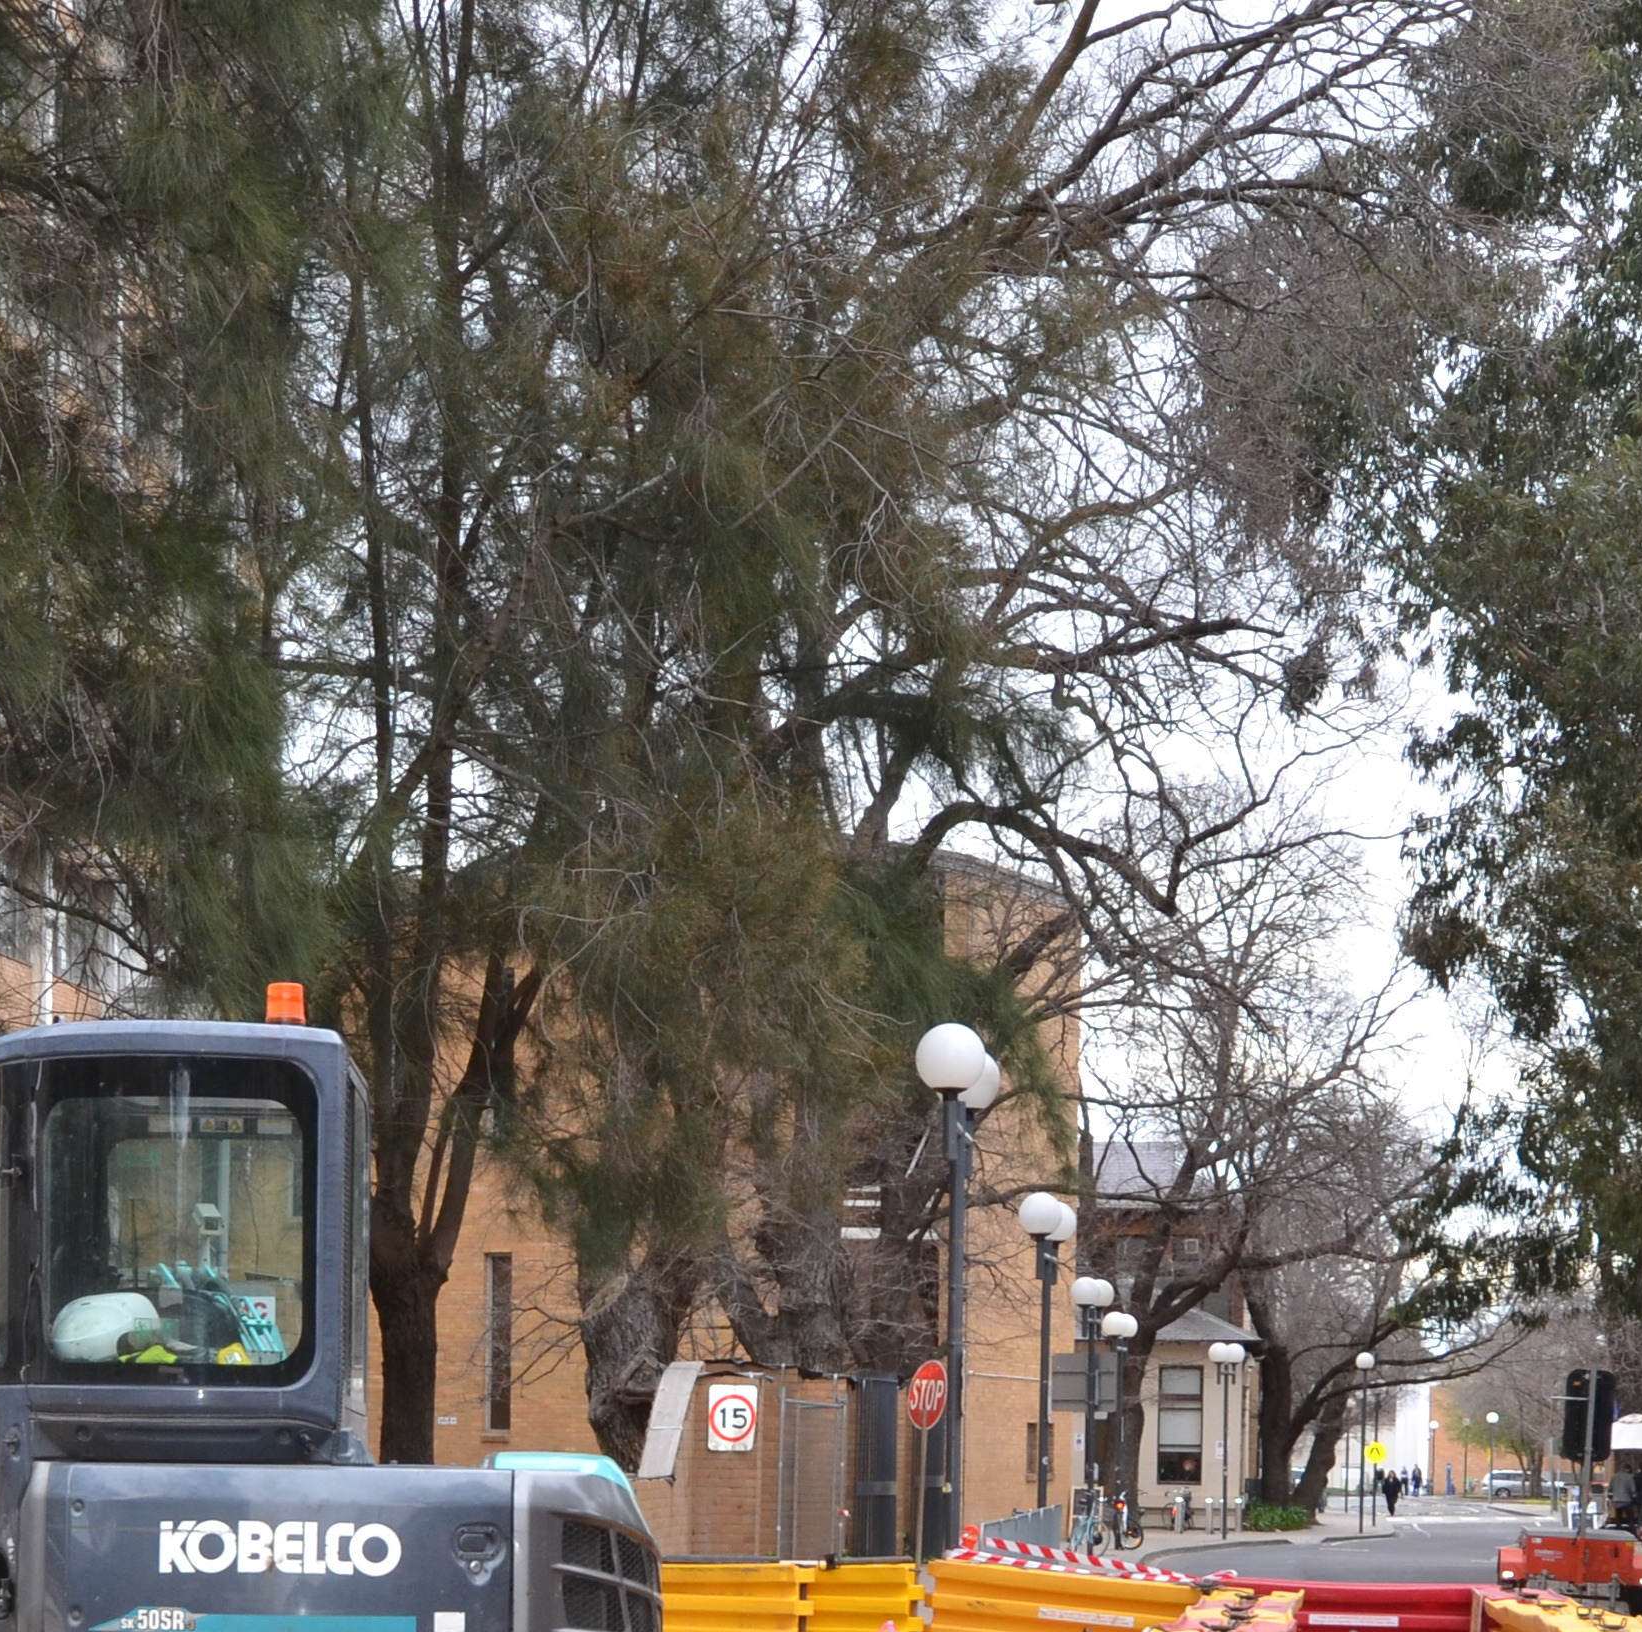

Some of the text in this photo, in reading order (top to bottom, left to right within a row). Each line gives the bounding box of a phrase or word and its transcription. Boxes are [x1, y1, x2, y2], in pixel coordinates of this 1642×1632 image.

[910, 1379, 944, 1411] STOP
[720, 1407, 747, 1429] 15
[158, 1520, 402, 1577] KOBELCO
